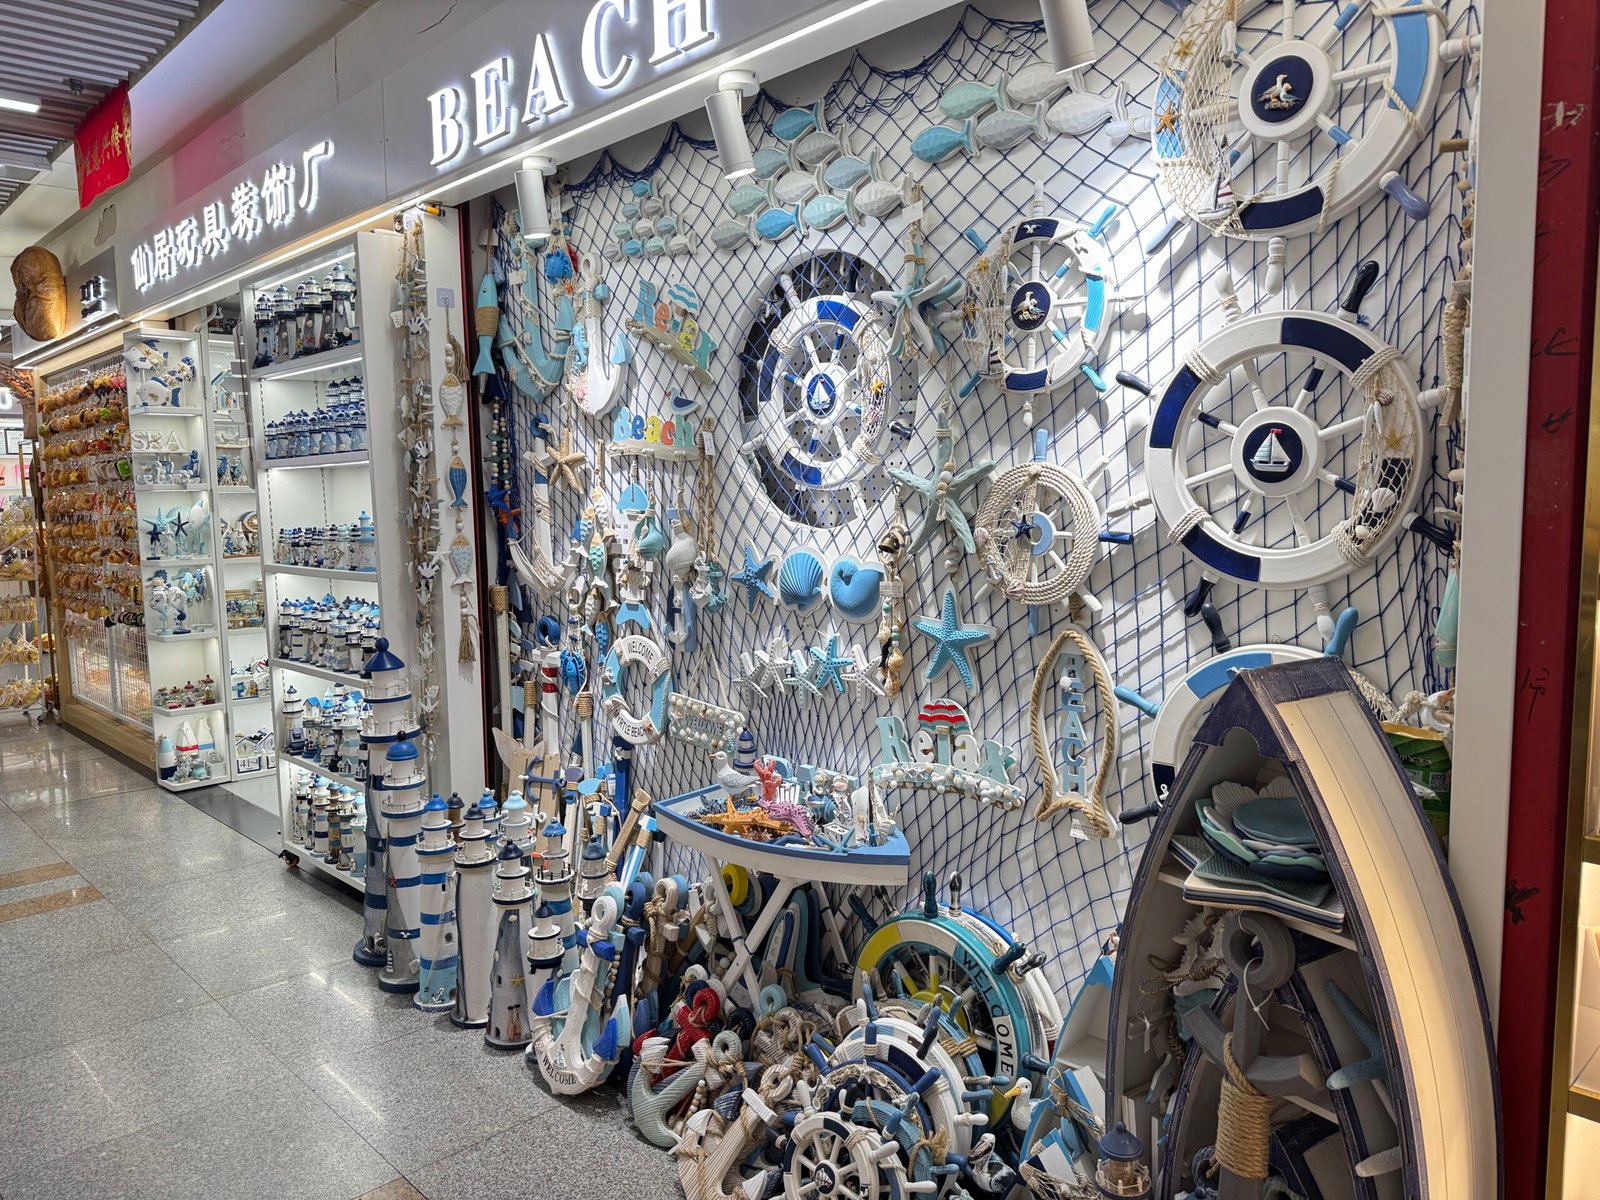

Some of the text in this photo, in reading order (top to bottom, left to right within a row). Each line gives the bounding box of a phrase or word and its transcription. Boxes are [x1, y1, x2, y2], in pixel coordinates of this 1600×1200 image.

[427, 0, 717, 167] BEACH
[131, 141, 333, 293] 仙居玩具装饰厂
[627, 641, 654, 664] WELCOME
[875, 716, 1017, 785] Relax
[1060, 653, 1089, 797] BEACH
[542, 1054, 577, 1085] WELCOME
[961, 950, 1014, 1077] WELCOME
